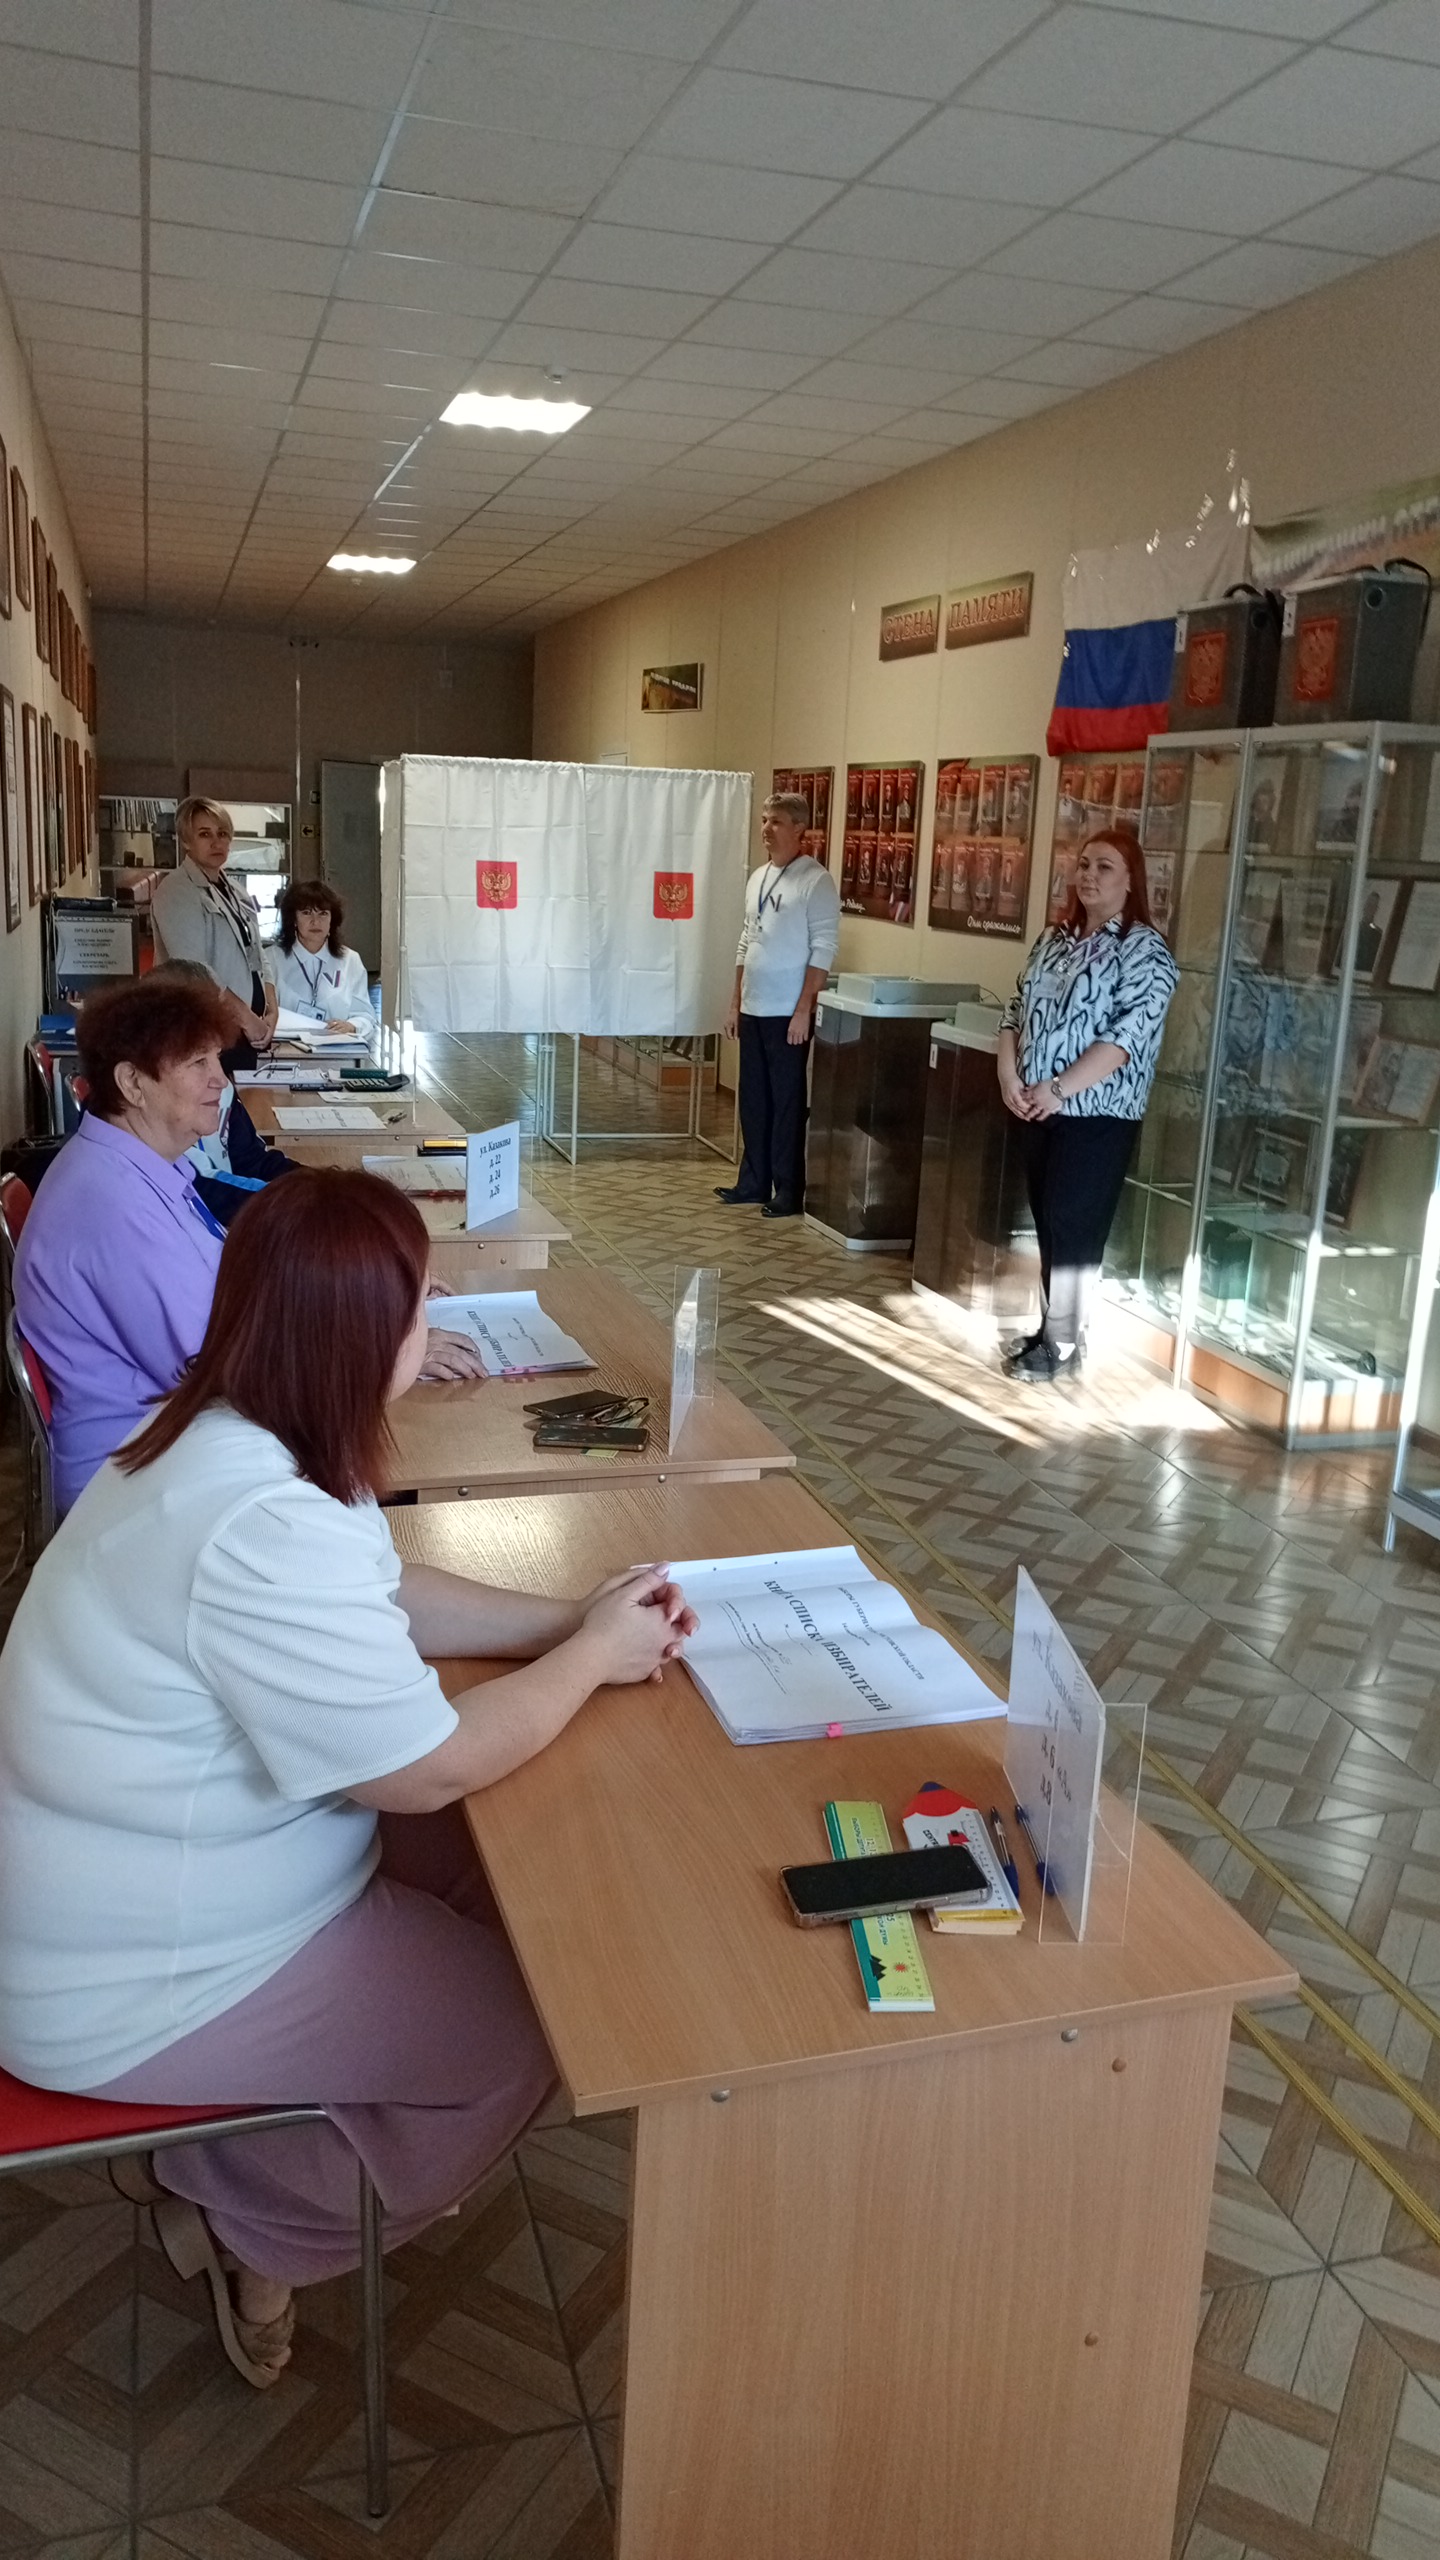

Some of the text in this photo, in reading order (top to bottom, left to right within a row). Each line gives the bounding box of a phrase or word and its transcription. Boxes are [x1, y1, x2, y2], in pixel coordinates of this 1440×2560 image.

[882, 586, 1025, 644] СТЕНА ПАМЯТИ
[967, 914, 982, 929] Они
[488, 1137, 511, 1152] Казакова
[495, 1153, 501, 1165] 22
[495, 1168, 501, 1180] 24
[764, 1579, 794, 1601] КНИГА
[821, 1642, 893, 1712] ИЗБИРАТЕЛЕЙ
